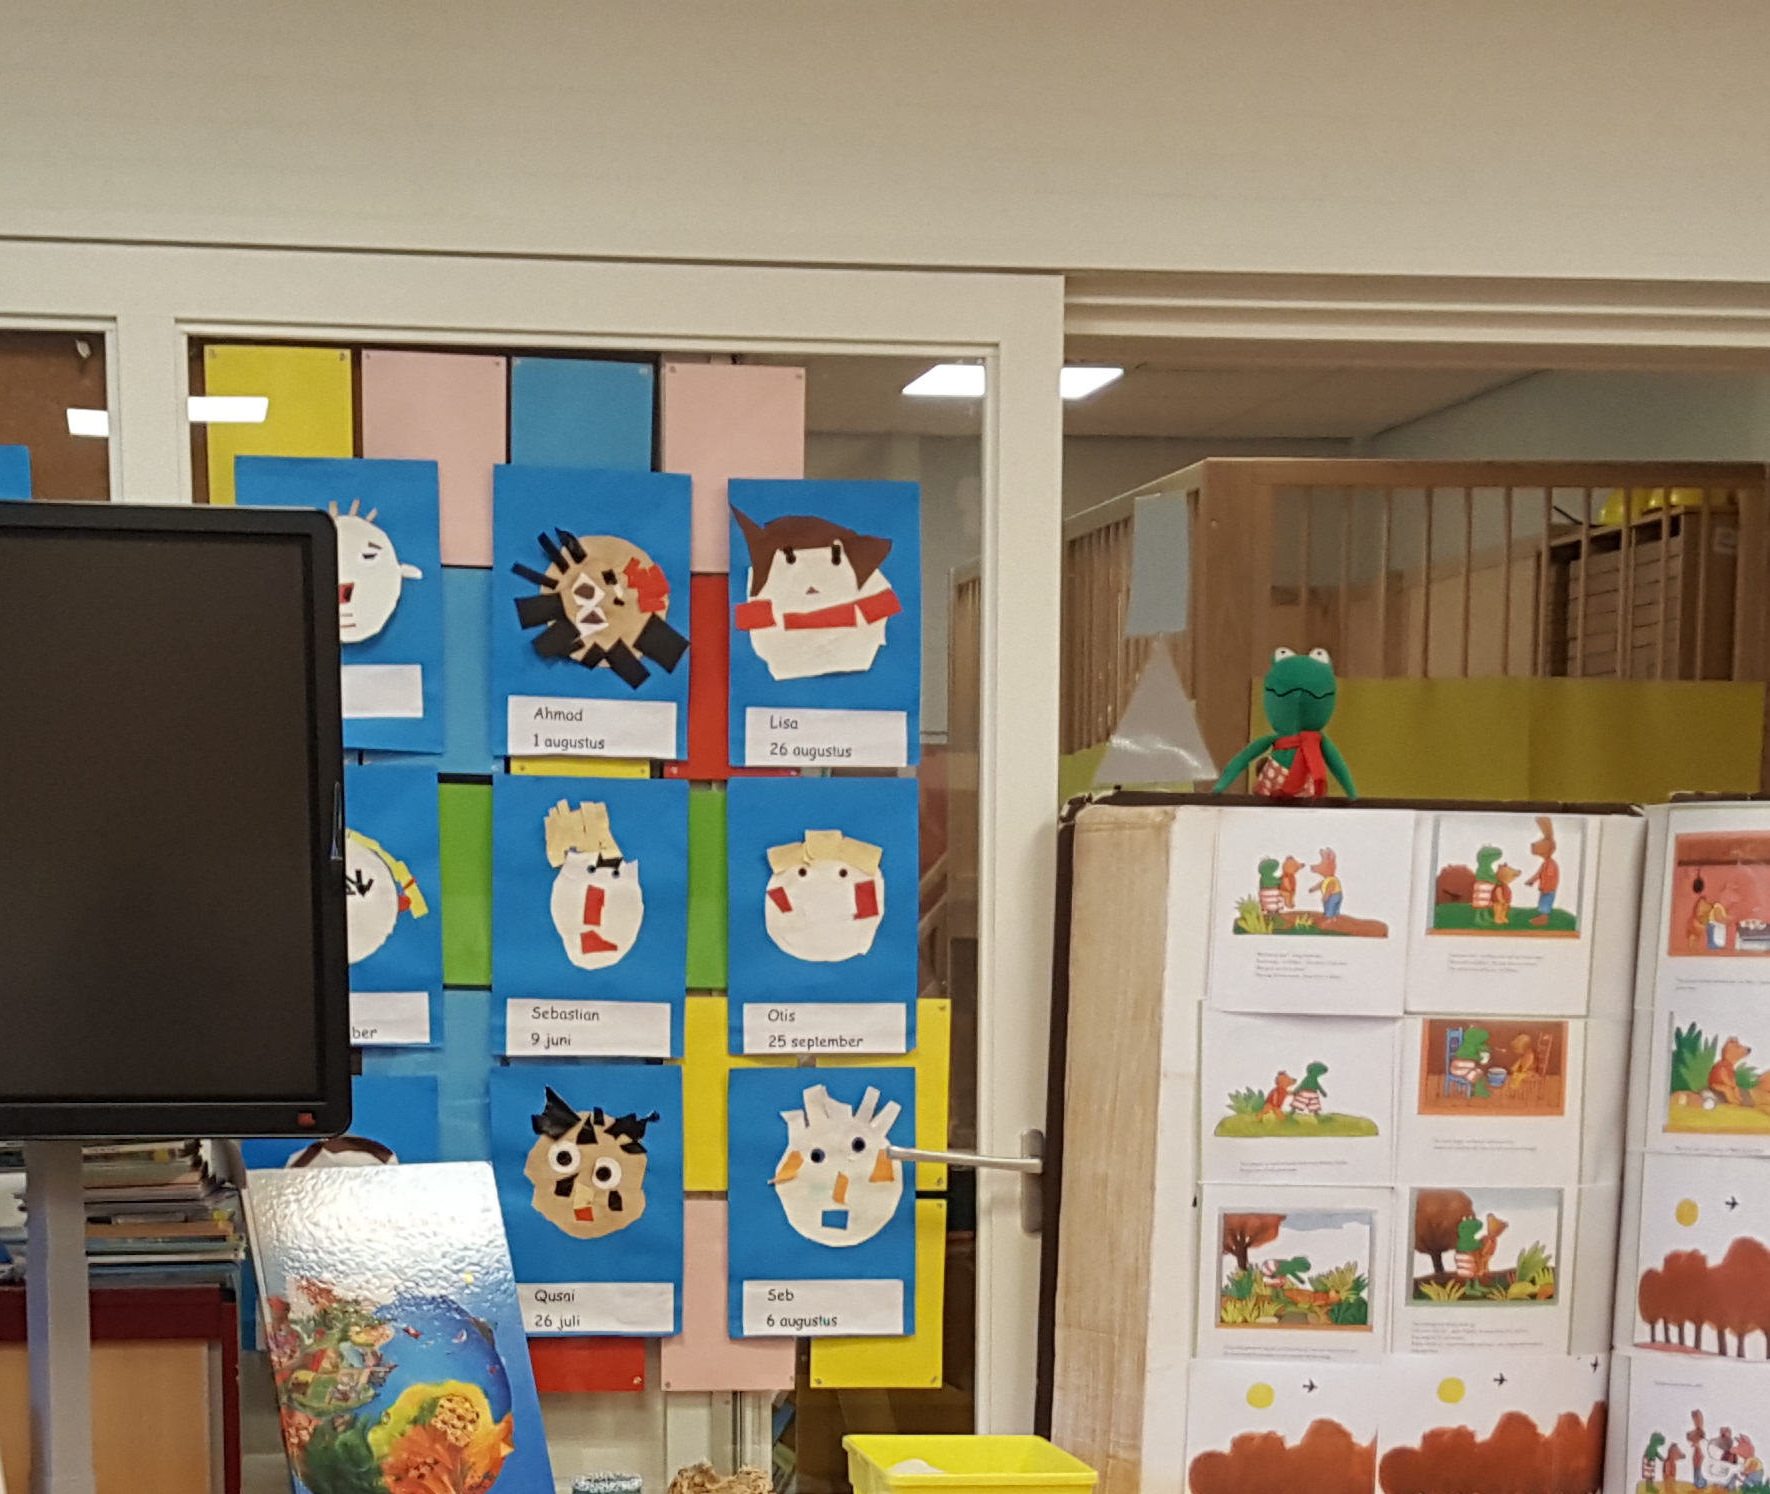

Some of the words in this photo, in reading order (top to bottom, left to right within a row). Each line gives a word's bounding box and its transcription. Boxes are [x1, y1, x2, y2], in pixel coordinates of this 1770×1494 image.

[534, 706, 583, 722] Ahmad
[770, 714, 798, 730] Lisa
[533, 733, 539, 747] 1
[544, 736, 605, 751] augustus
[770, 742, 788, 756] 26
[793, 744, 852, 761] augustus
[531, 1006, 600, 1021] Sebastian
[767, 1008, 796, 1022] Otis
[531, 1032, 540, 1046] 9
[544, 1033, 571, 1049] juni
[768, 1035, 786, 1048] 25
[791, 1035, 864, 1050] september
[534, 1289, 575, 1304] Qusai
[767, 1288, 794, 1301] Seb
[534, 1314, 552, 1328] 26
[557, 1314, 580, 1331] juli
[766, 1314, 775, 1328] 6
[780, 1314, 838, 1331] augustus
